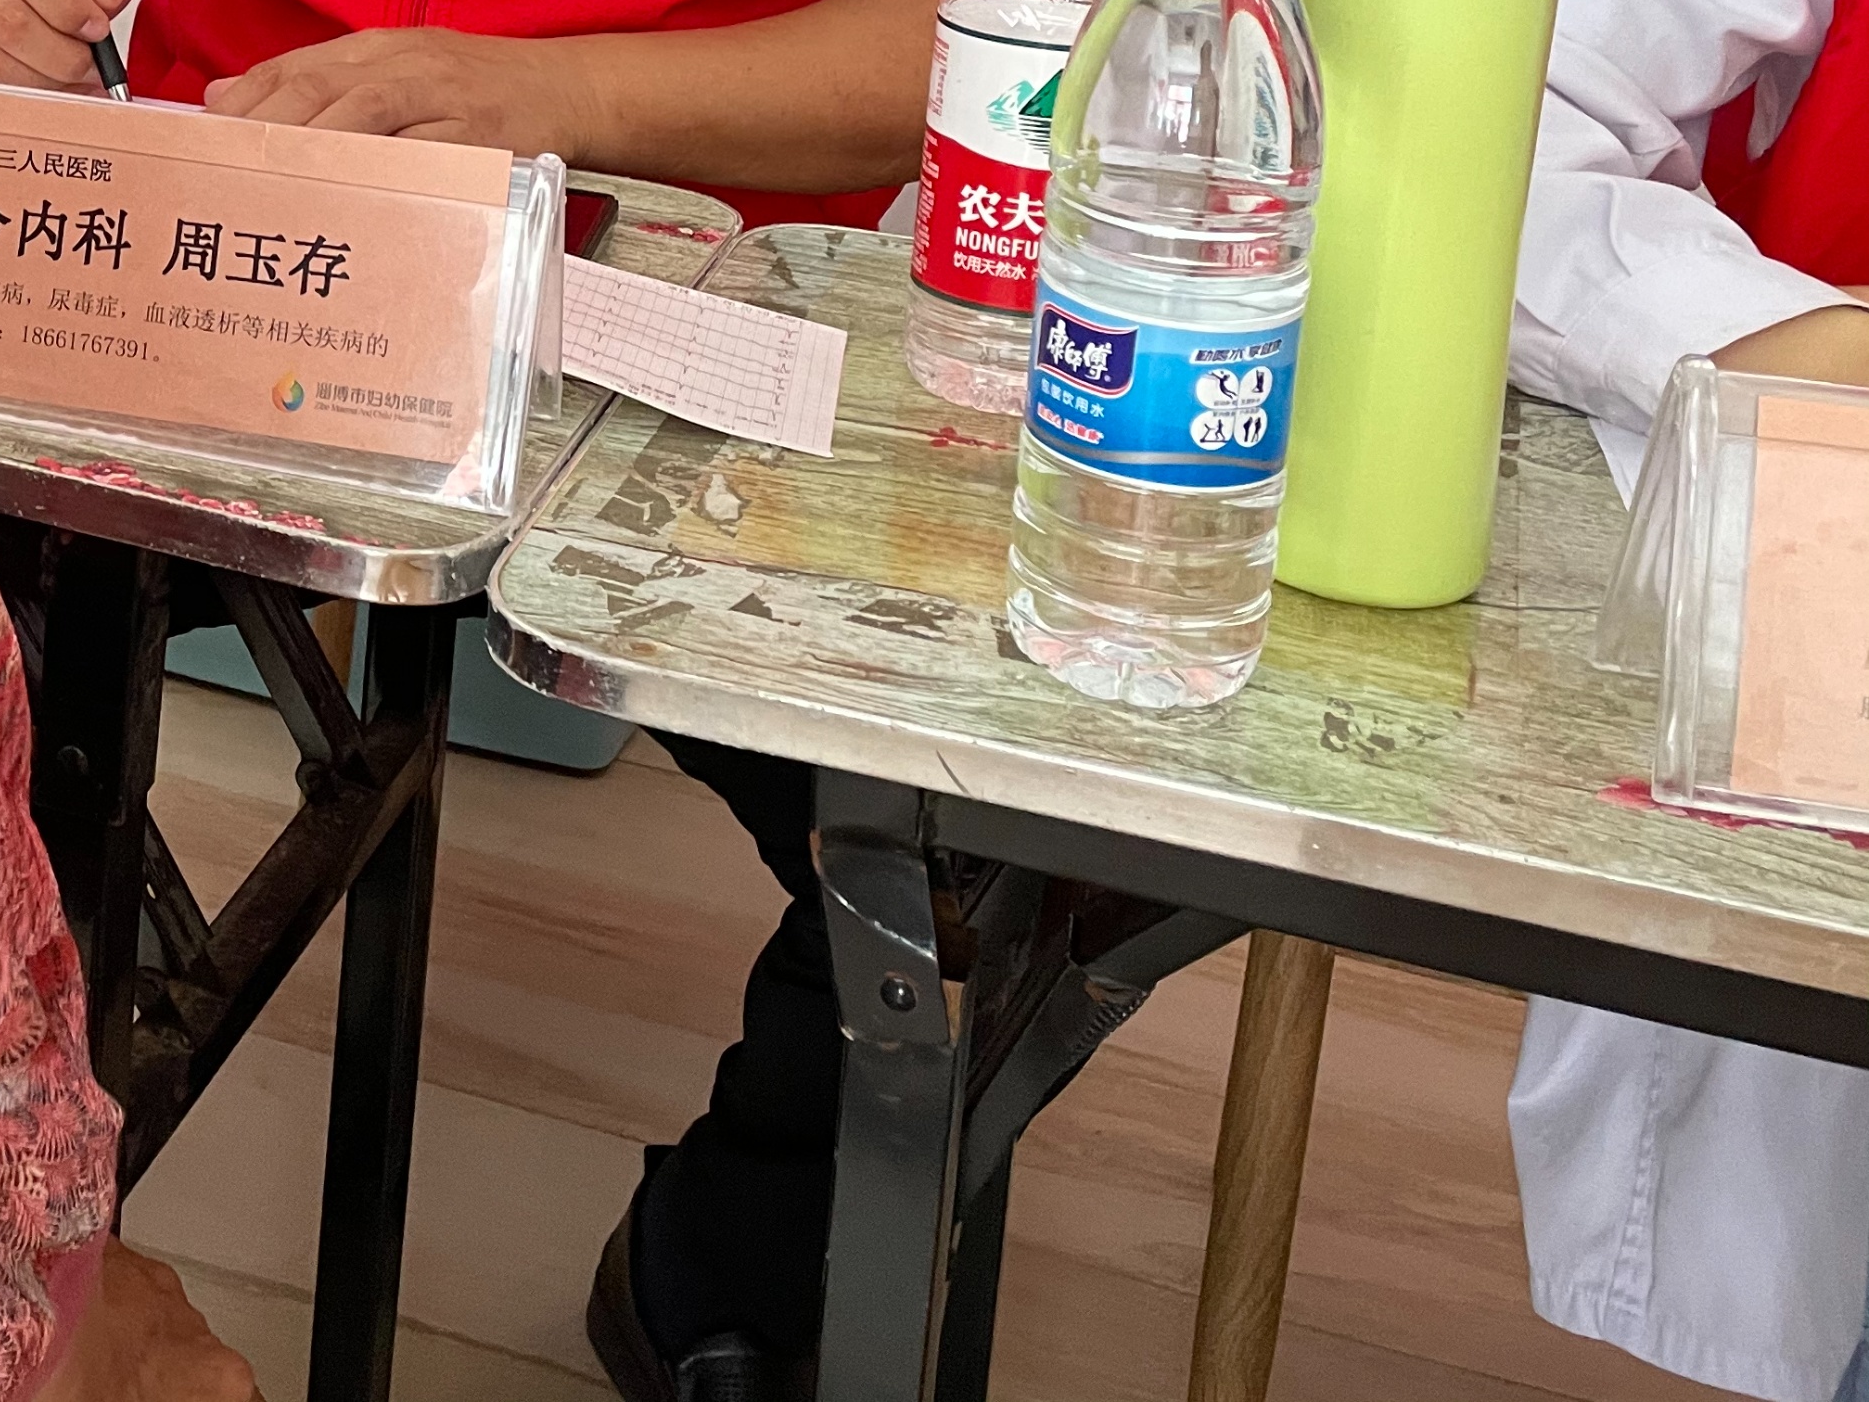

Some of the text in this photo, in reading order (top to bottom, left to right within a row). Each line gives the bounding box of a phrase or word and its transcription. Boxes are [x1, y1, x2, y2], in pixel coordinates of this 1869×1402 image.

[958, 184, 1045, 236] 农夫
[161, 218, 352, 298] 周玉存
[955, 226, 1039, 261] NONGFU
[953, 250, 1027, 280] 饮用天然水
[315, 382, 454, 419] 淄博市妇幼保健院
